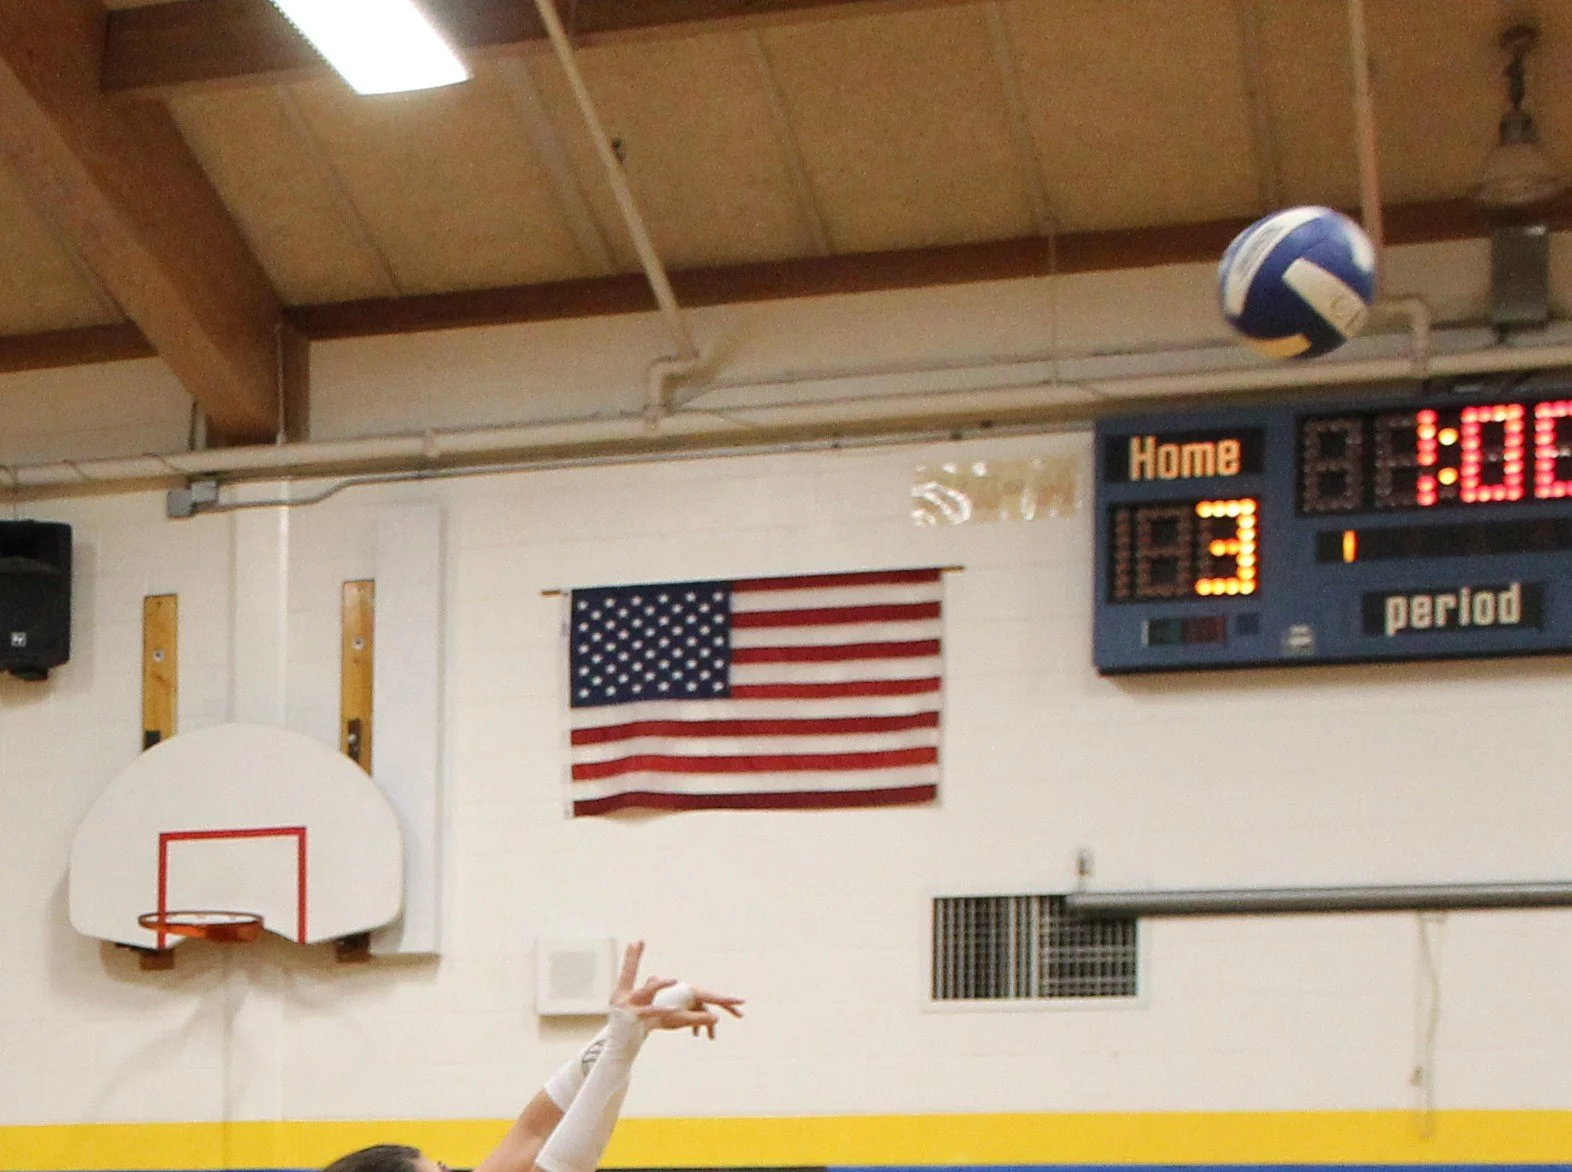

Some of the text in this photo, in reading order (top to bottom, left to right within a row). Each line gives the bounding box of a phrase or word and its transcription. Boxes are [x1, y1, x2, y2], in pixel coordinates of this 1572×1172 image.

[1129, 437, 1241, 480] Home
[1195, 498, 1257, 595] 3
[1385, 581, 1522, 638] period
